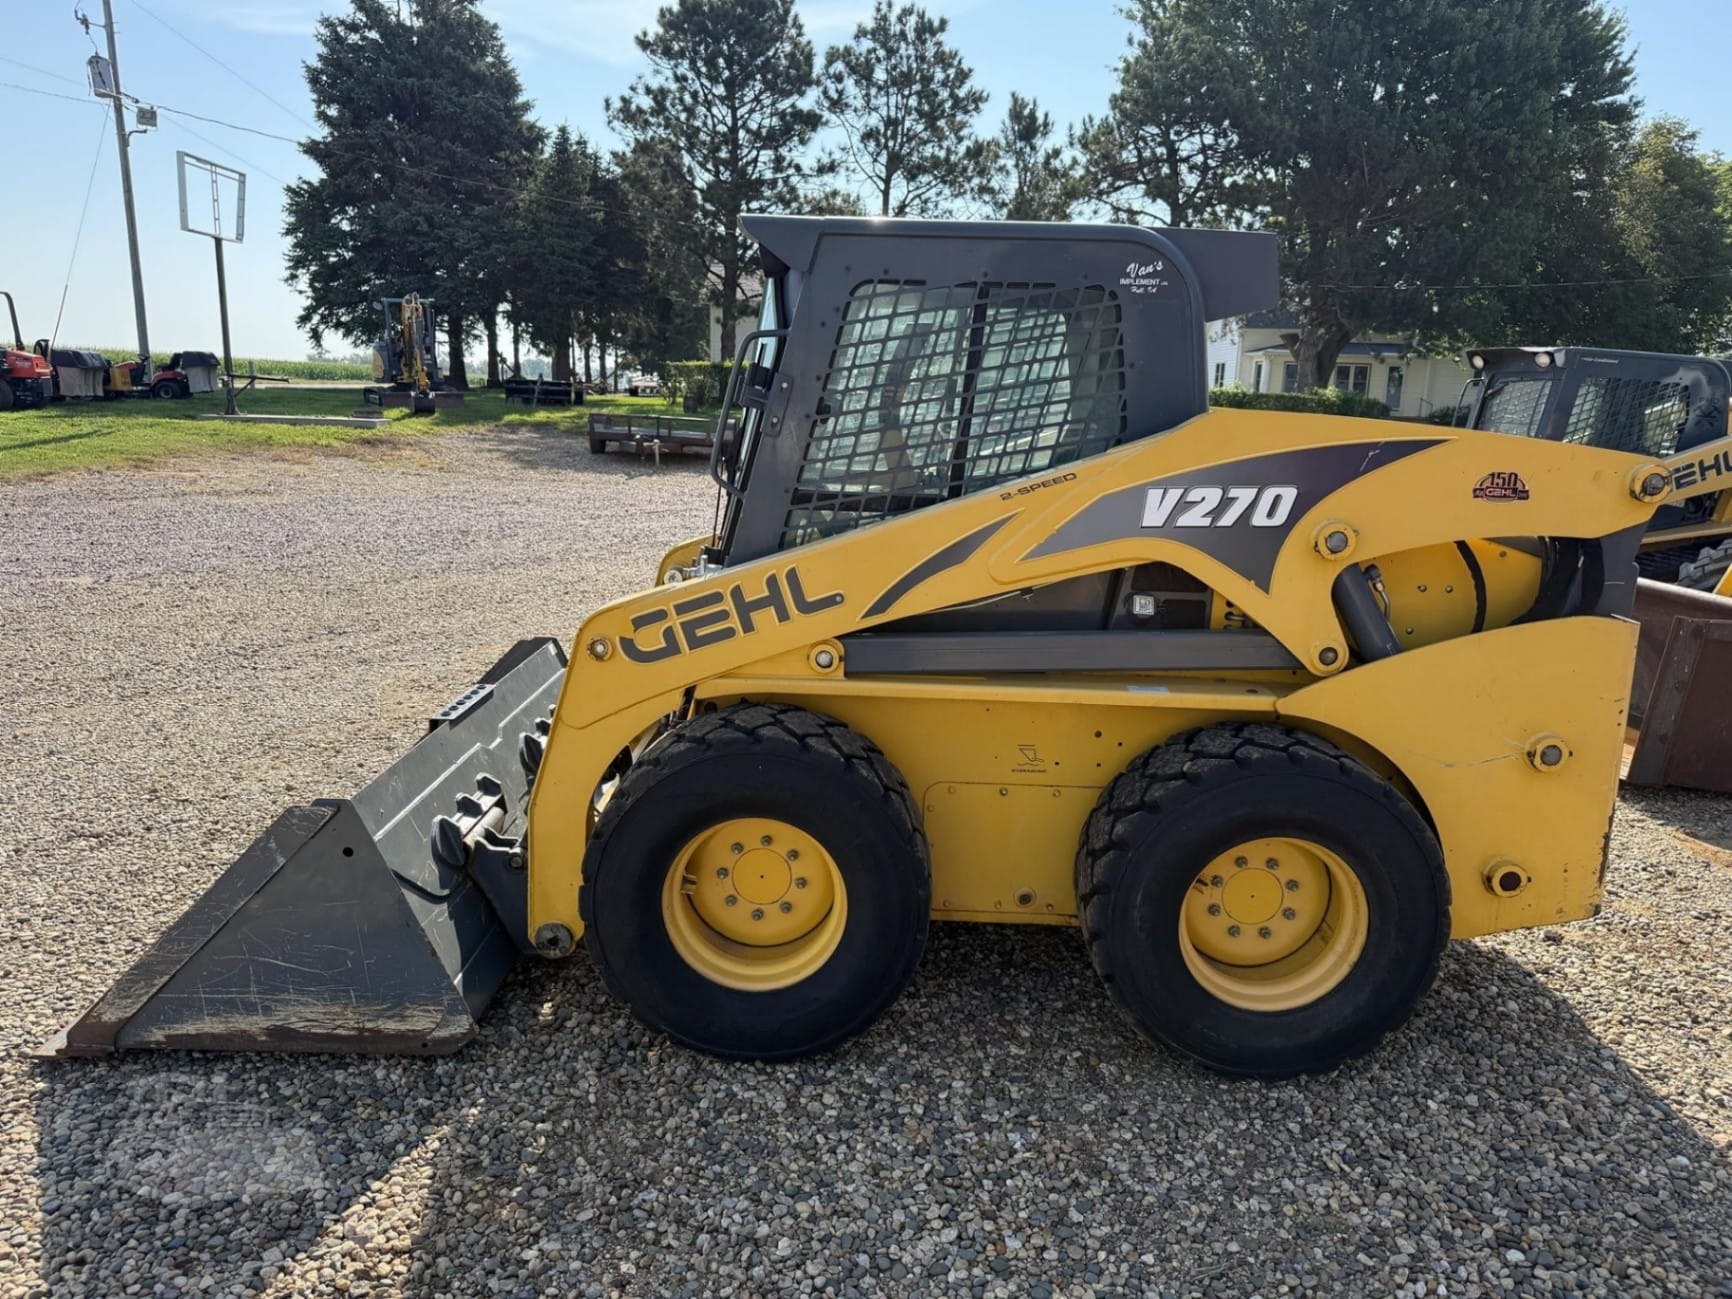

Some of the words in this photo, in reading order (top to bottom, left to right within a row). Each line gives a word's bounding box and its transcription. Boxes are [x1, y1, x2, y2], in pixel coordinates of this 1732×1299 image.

[1119, 278, 1161, 286] IMPLEMENT
[1126, 260, 1163, 278] Van's
[1488, 472, 1518, 487] 150
[1671, 450, 1732, 490] EHL
[1000, 472, 1077, 501] 2-SPEED
[1141, 486, 1298, 528] V270
[619, 566, 845, 663] GEHL
